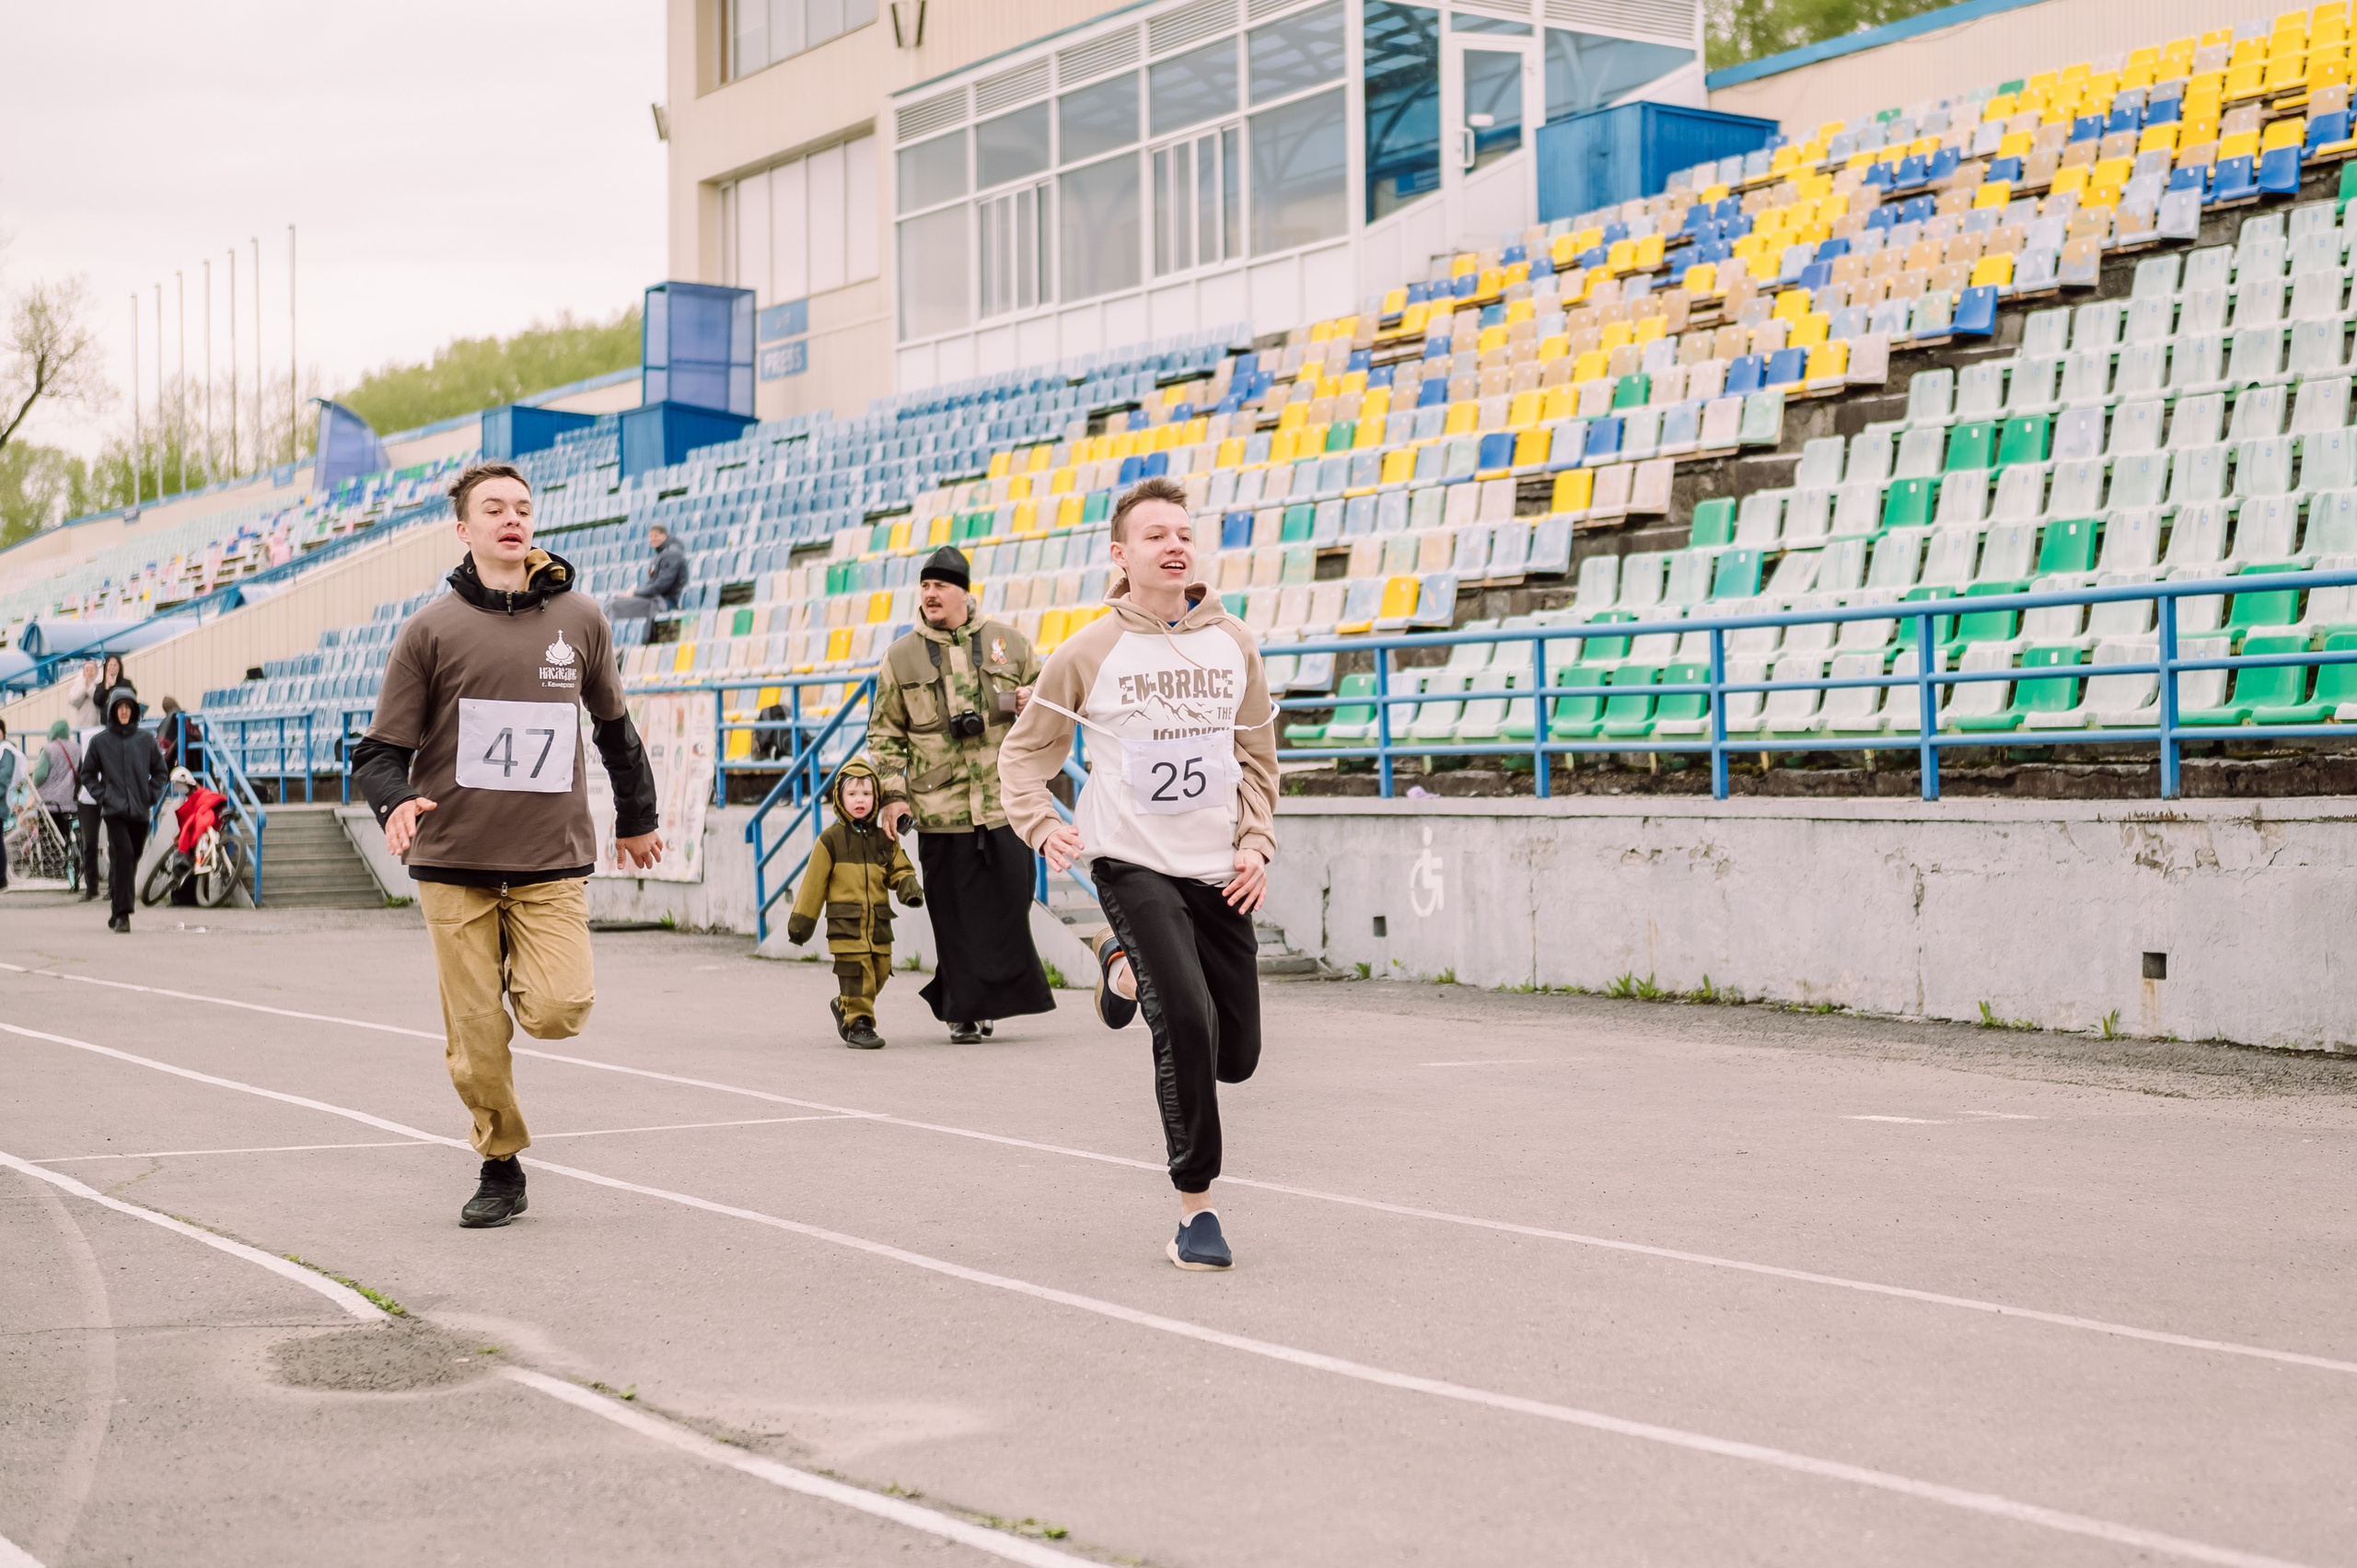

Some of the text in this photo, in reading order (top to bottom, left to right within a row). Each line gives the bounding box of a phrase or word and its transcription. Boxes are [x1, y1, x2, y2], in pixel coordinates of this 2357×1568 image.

[1119, 668, 1234, 705] EMBRACE
[1217, 706, 1233, 720] THE
[482, 727, 555, 778] 47
[1151, 756, 1207, 801] 25
